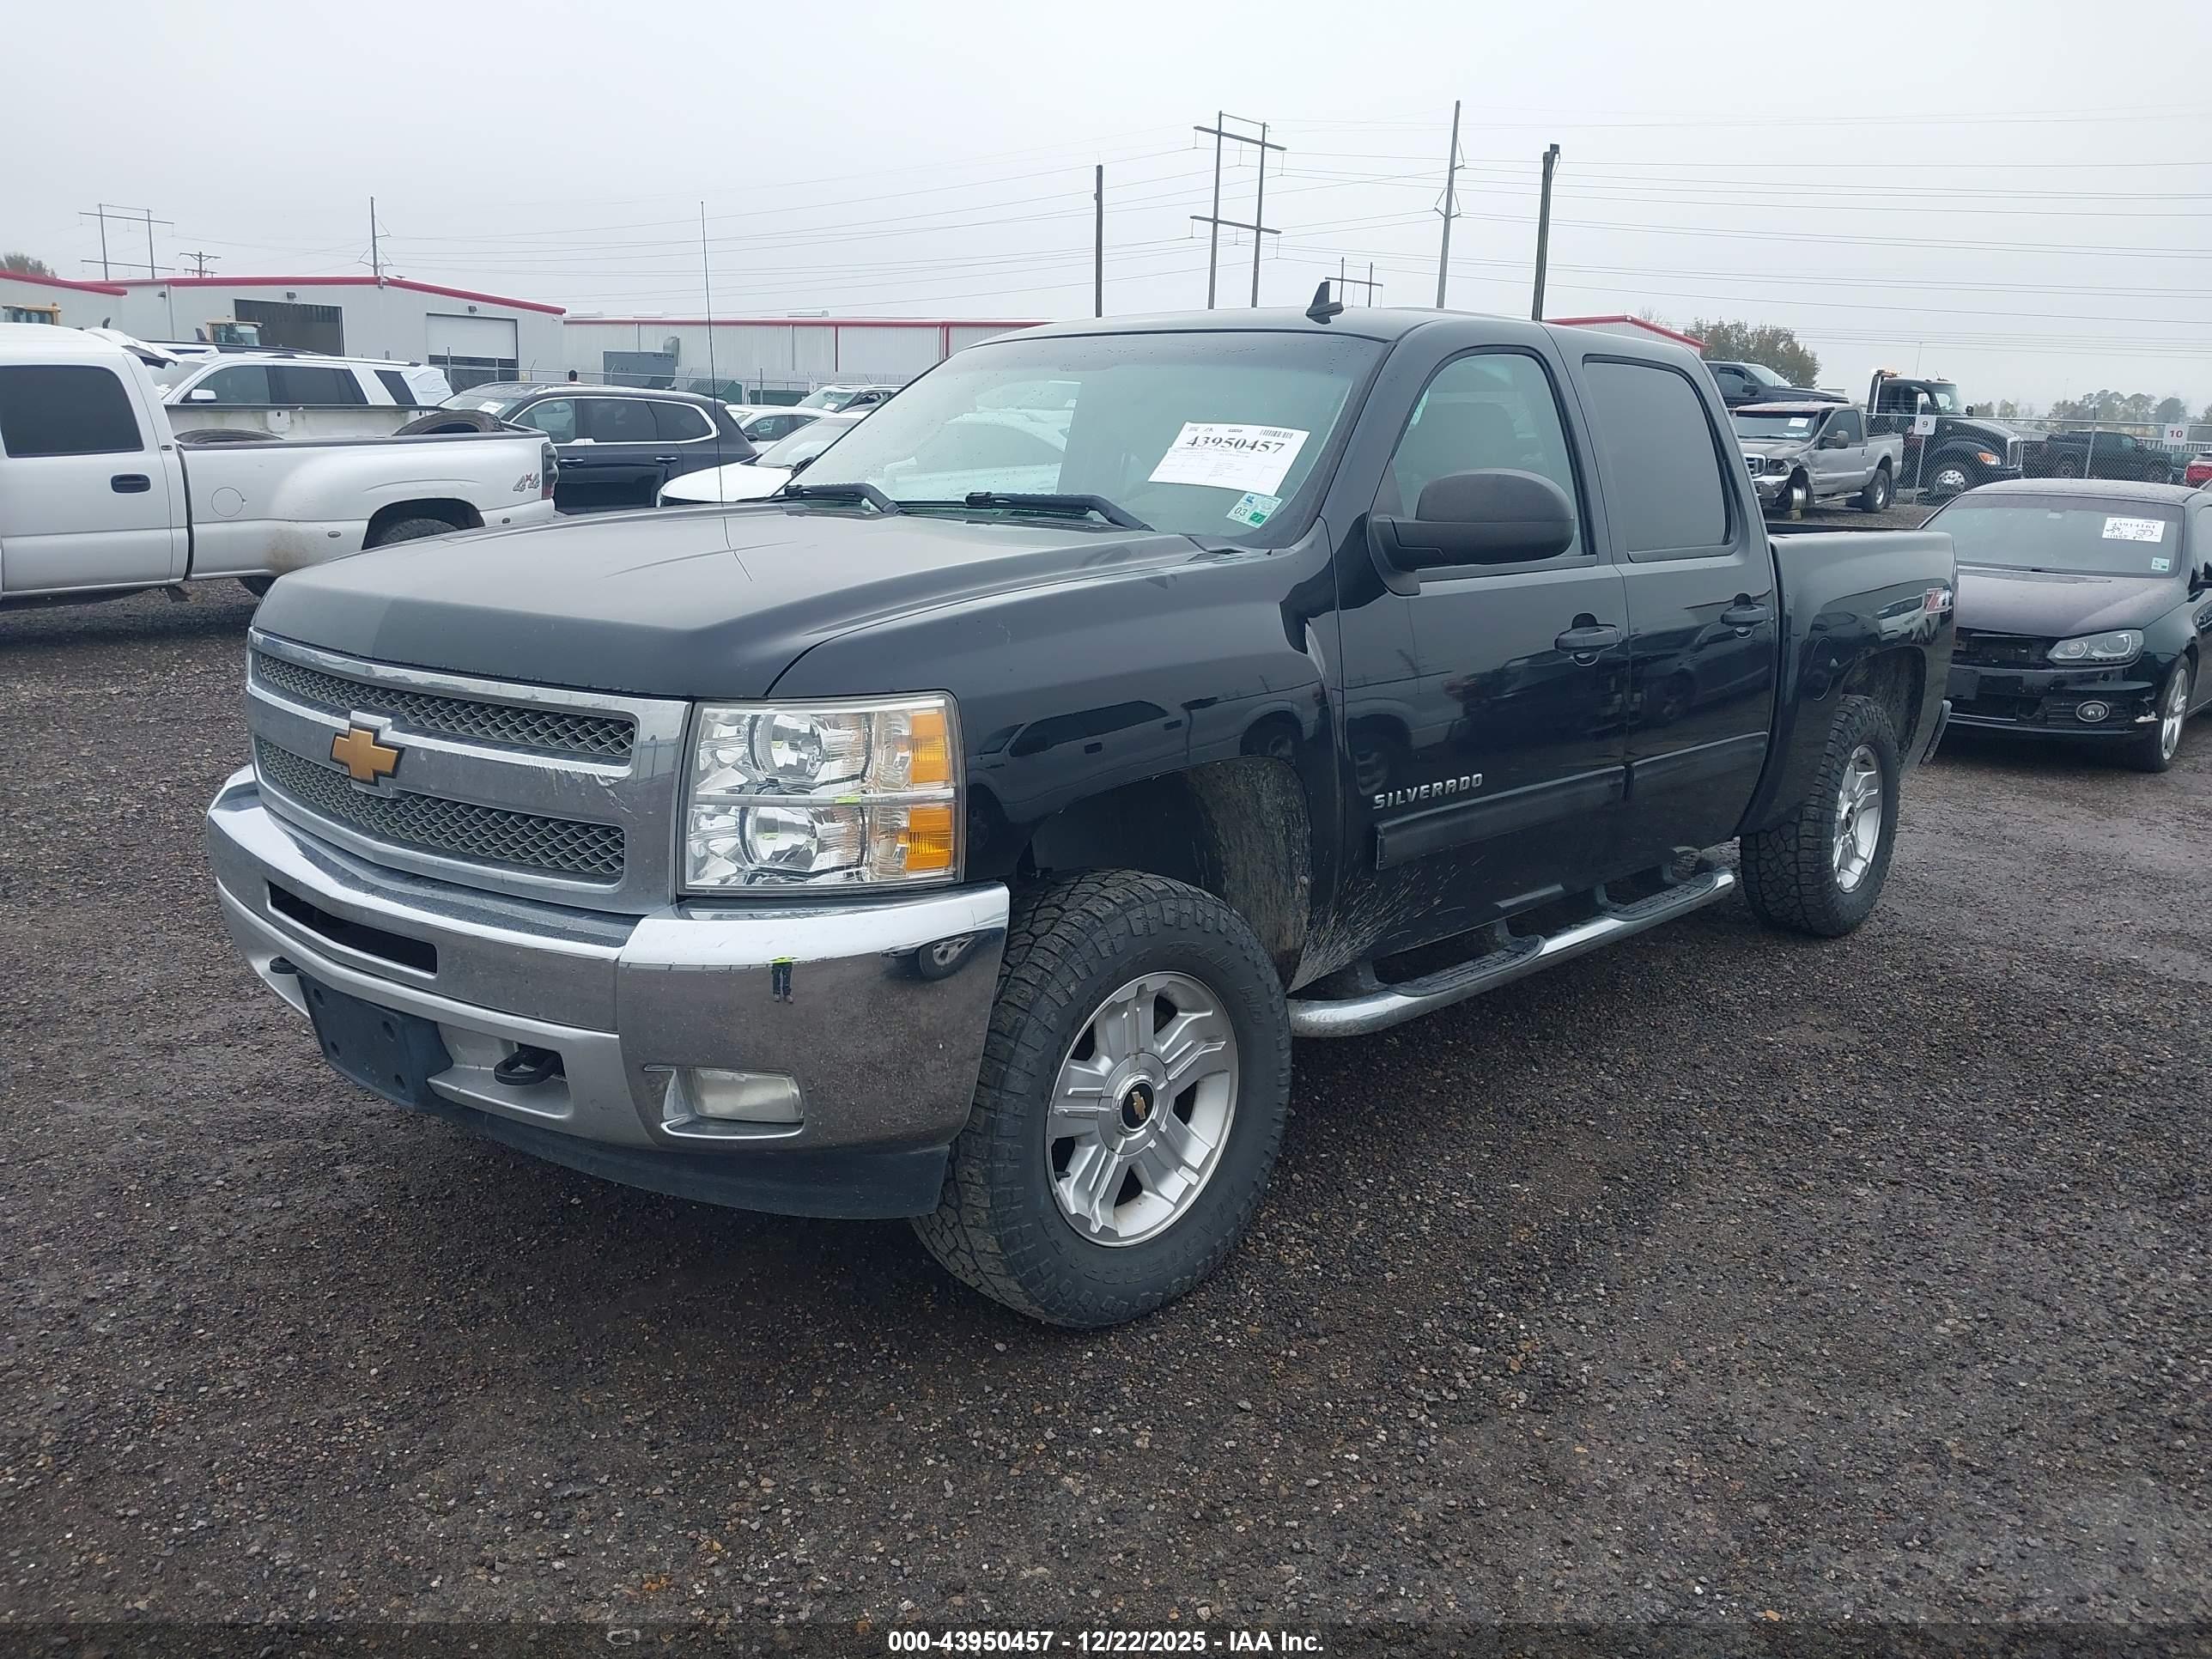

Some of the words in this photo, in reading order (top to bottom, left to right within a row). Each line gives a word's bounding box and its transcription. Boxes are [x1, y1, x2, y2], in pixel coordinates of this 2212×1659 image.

[1186, 434, 1285, 454] 43950457
[1235, 507, 1248, 516] 03
[1372, 773, 1484, 810] SILVERADO
